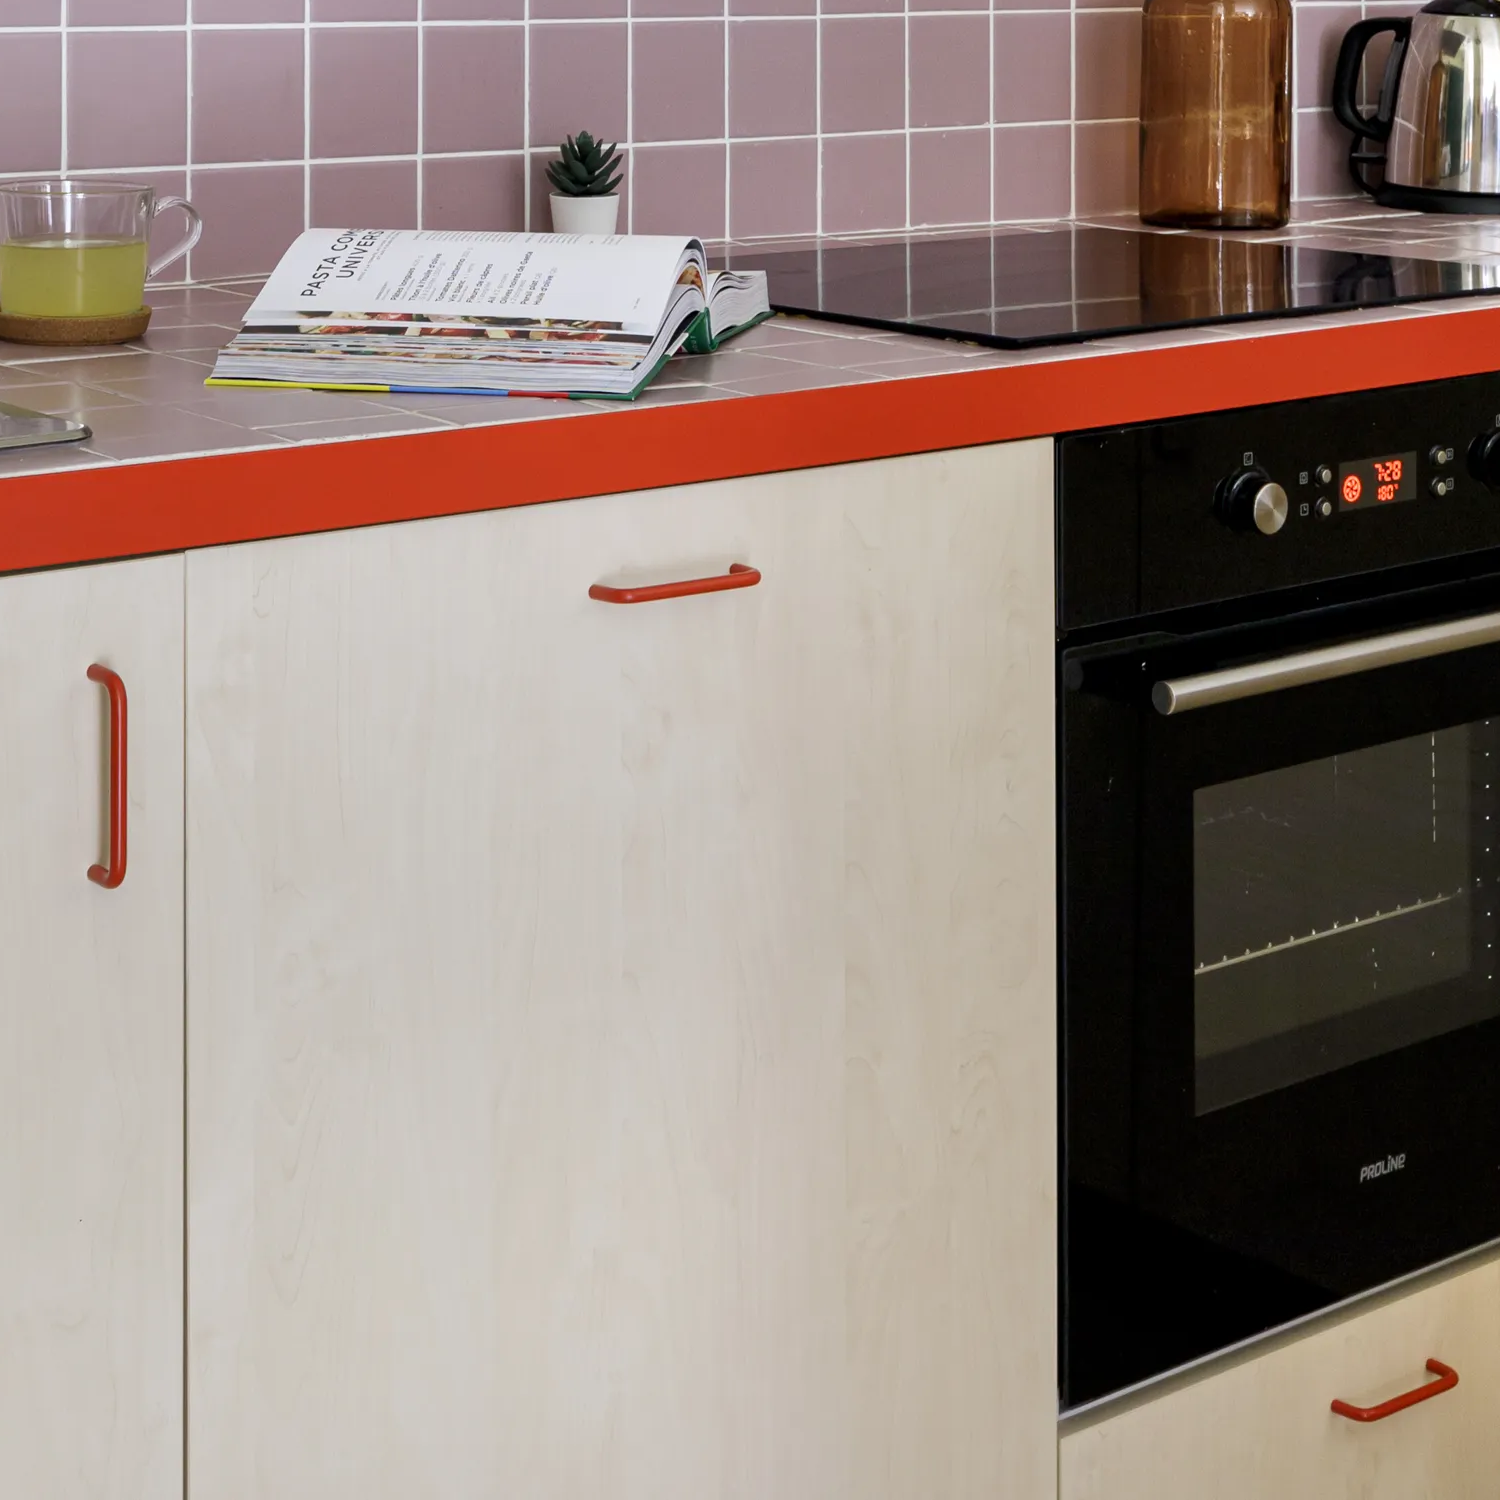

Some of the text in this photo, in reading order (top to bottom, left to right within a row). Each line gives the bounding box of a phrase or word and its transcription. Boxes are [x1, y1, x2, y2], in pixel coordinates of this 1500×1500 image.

[336, 231, 384, 278] UNIVERS
[300, 256, 341, 297] PASTA
[498, 288, 513, 303] Olives
[507, 273, 521, 287] noires
[1374, 460, 1402, 481] 7:28
